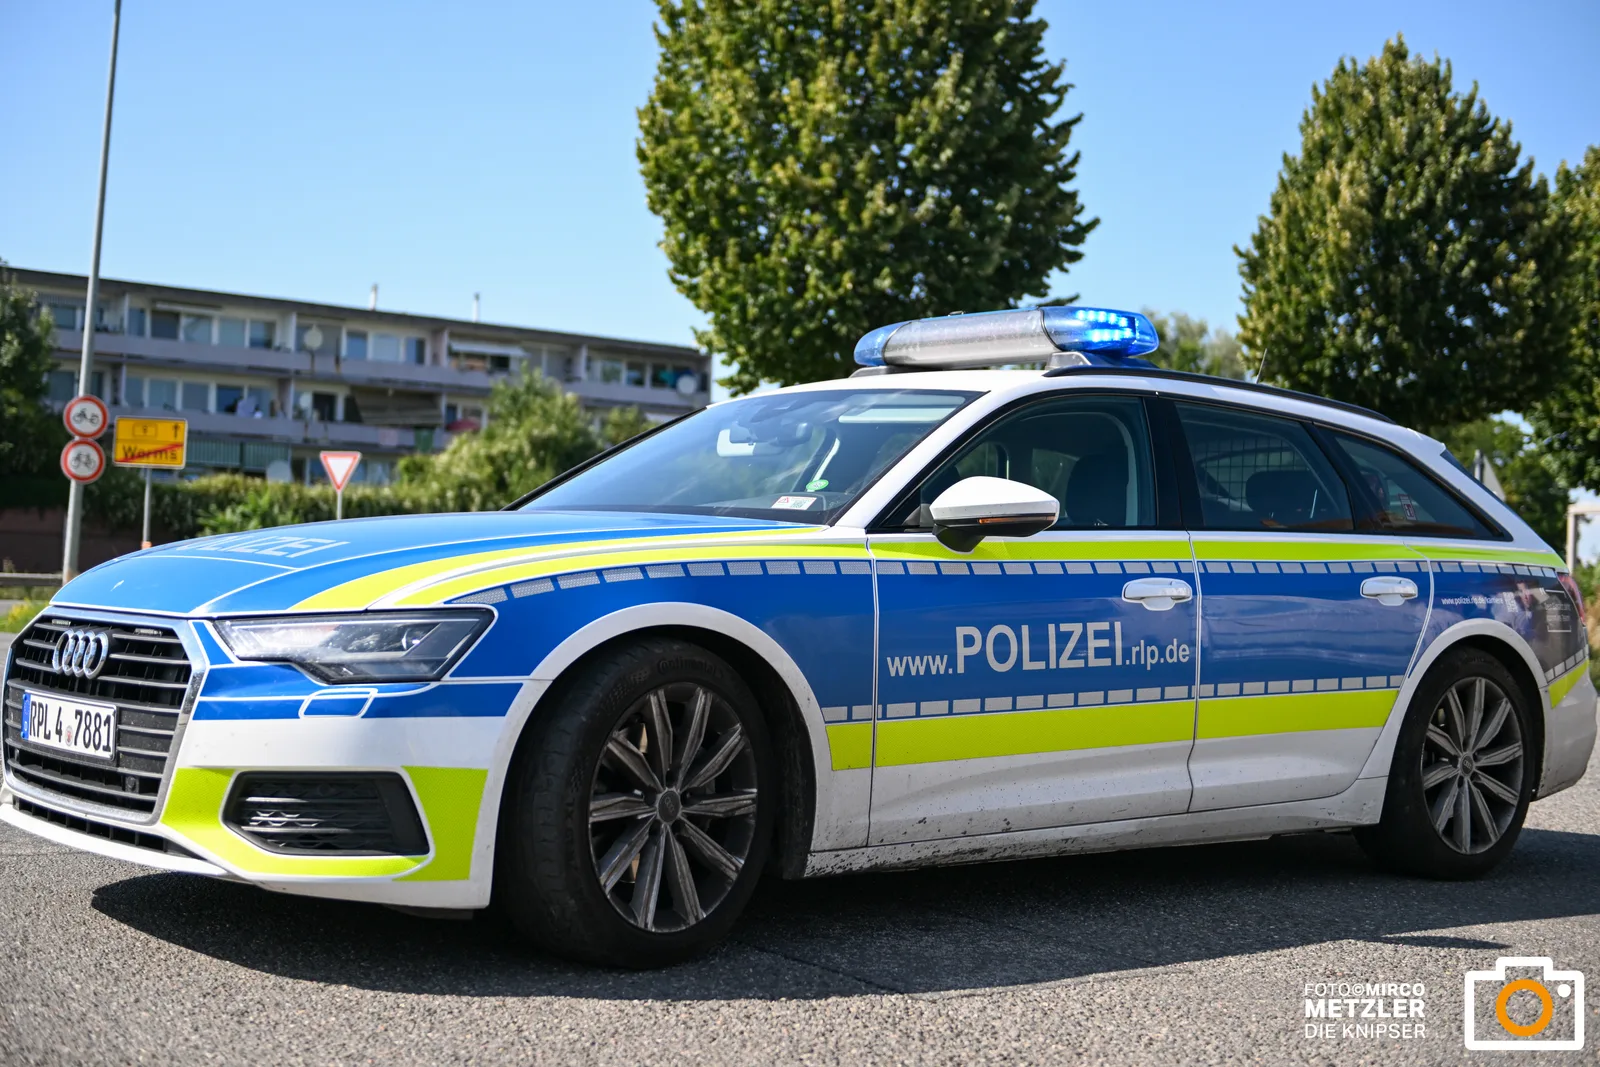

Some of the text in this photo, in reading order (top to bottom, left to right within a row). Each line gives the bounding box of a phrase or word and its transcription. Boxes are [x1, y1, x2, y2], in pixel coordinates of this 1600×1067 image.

[122, 443, 178, 461] Worms
[886, 621, 1190, 677] www.POLIZEI.rlp.de
[29, 700, 112, 753] RPL 4 7881
